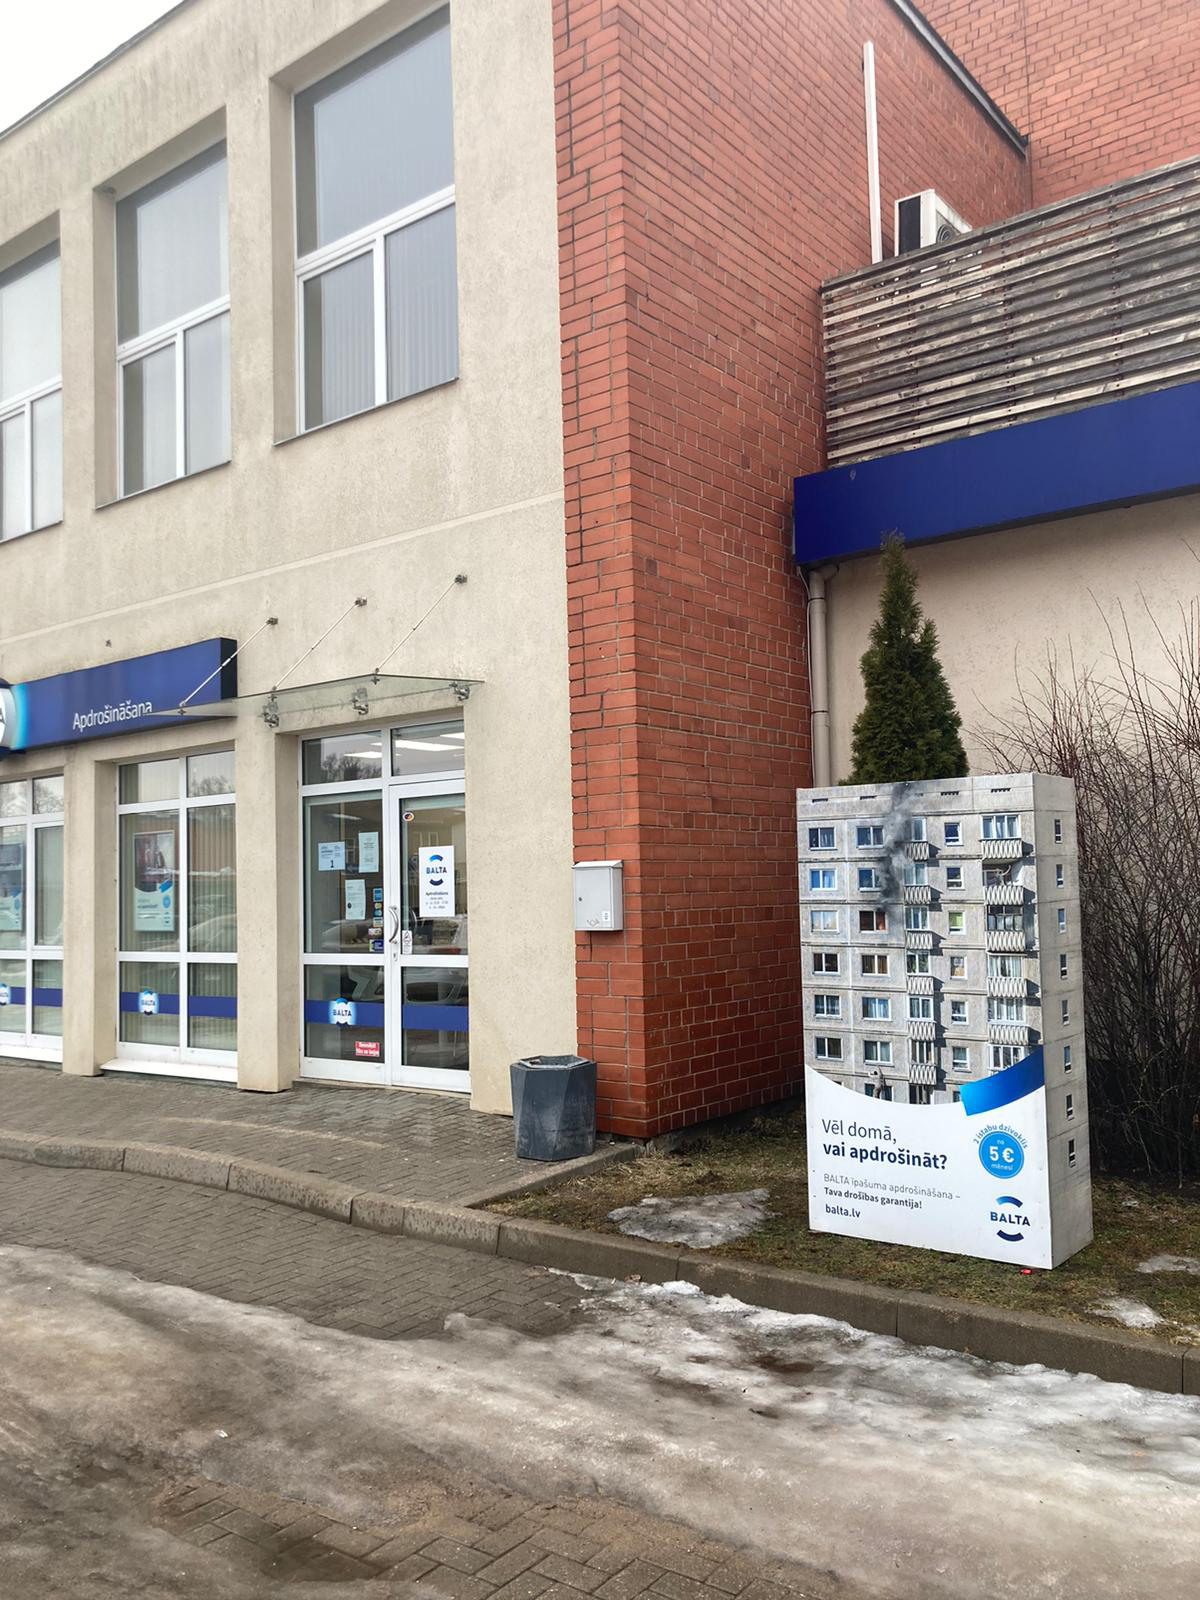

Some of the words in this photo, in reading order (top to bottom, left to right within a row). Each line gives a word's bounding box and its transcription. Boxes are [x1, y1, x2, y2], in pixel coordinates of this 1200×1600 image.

[73, 700, 152, 732] Apdrošināšana
[822, 1119, 844, 1136] Vēl
[848, 1121, 897, 1144] domā,
[823, 1141, 845, 1157] vai
[850, 1146, 948, 1170] apdrošināt?
[990, 1146, 999, 1161] 5
[1002, 1147, 1015, 1163] €
[823, 1173, 850, 1185] BALTA
[851, 1177, 887, 1191] īpašuma
[889, 1184, 953, 1200] apdrošināšana
[824, 1187, 843, 1197] Tava
[844, 1190, 879, 1203] drošības
[880, 1197, 922, 1210] garantija!
[825, 1204, 861, 1218] balta.lv
[990, 1211, 1031, 1226] BALTA
